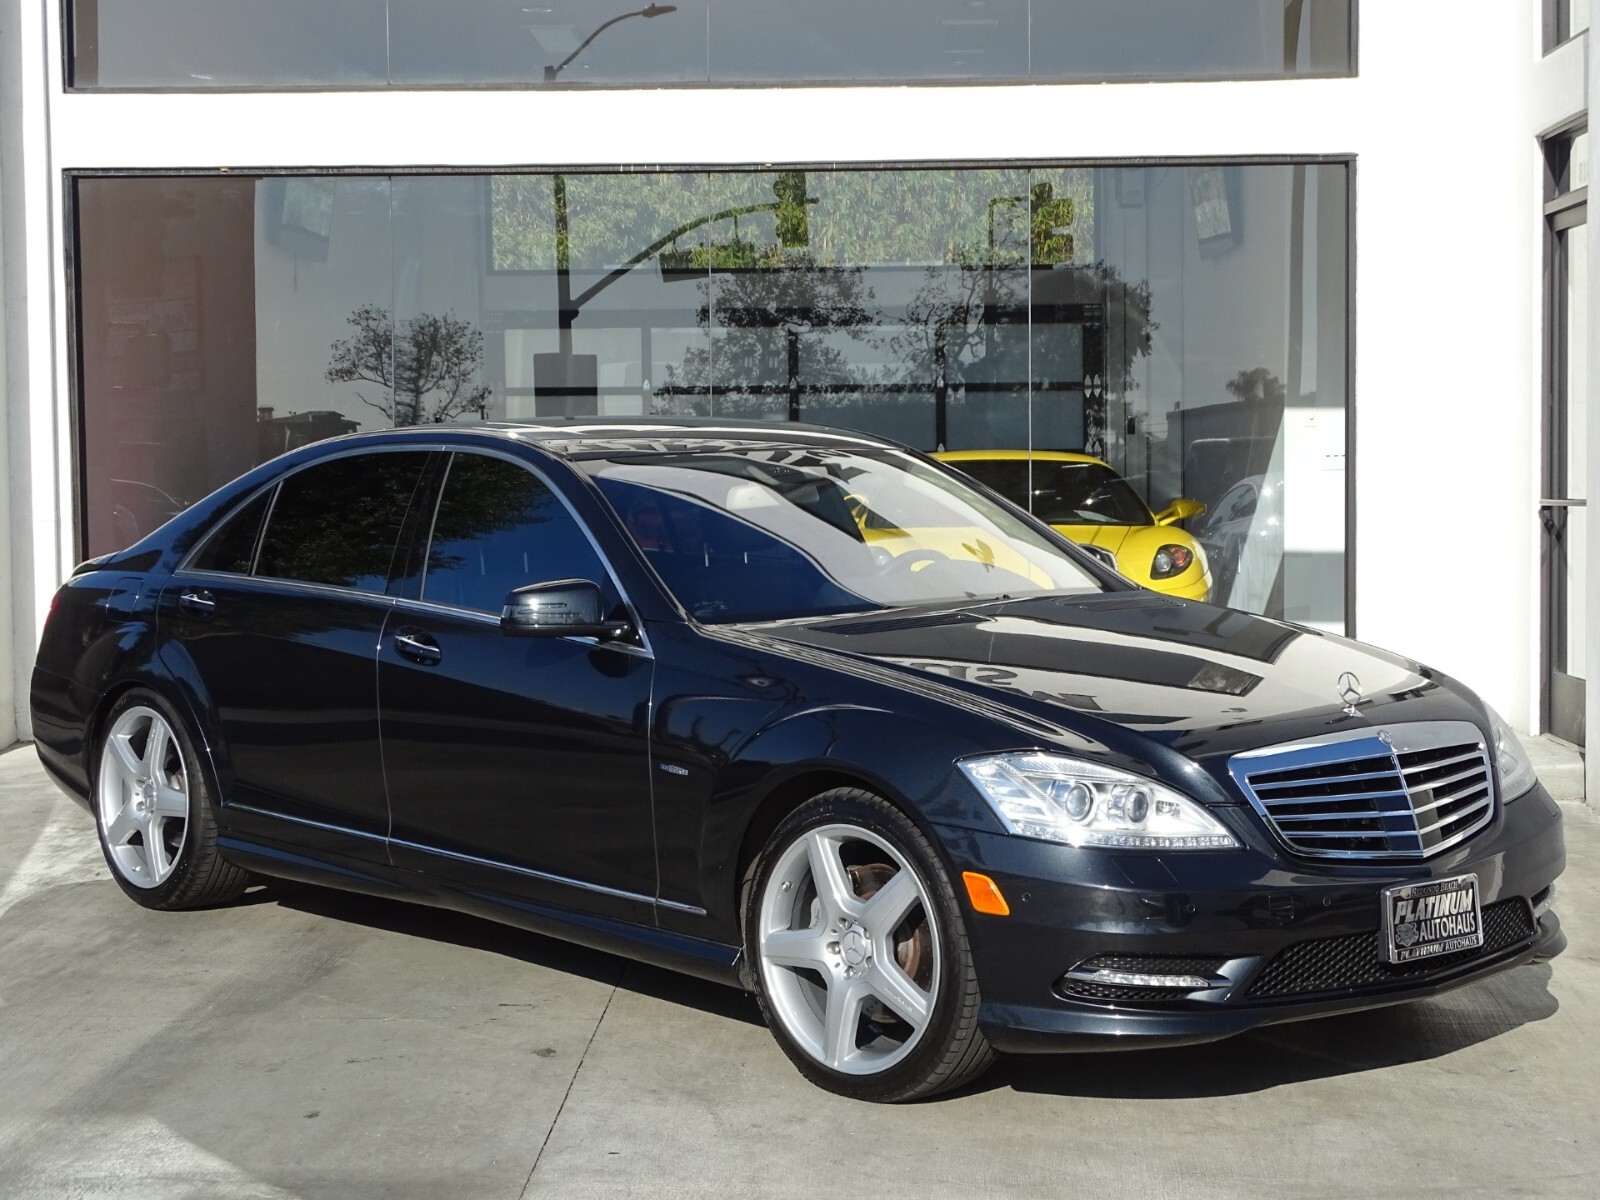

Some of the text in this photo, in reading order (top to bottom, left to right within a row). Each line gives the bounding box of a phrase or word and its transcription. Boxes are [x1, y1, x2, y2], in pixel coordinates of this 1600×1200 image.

[1440, 881, 1458, 892] BEACH
[1395, 889, 1473, 925] PLATINUM
[1419, 912, 1476, 941] AUTOHAUS
[1445, 936, 1477, 951] AUTOHAUS
